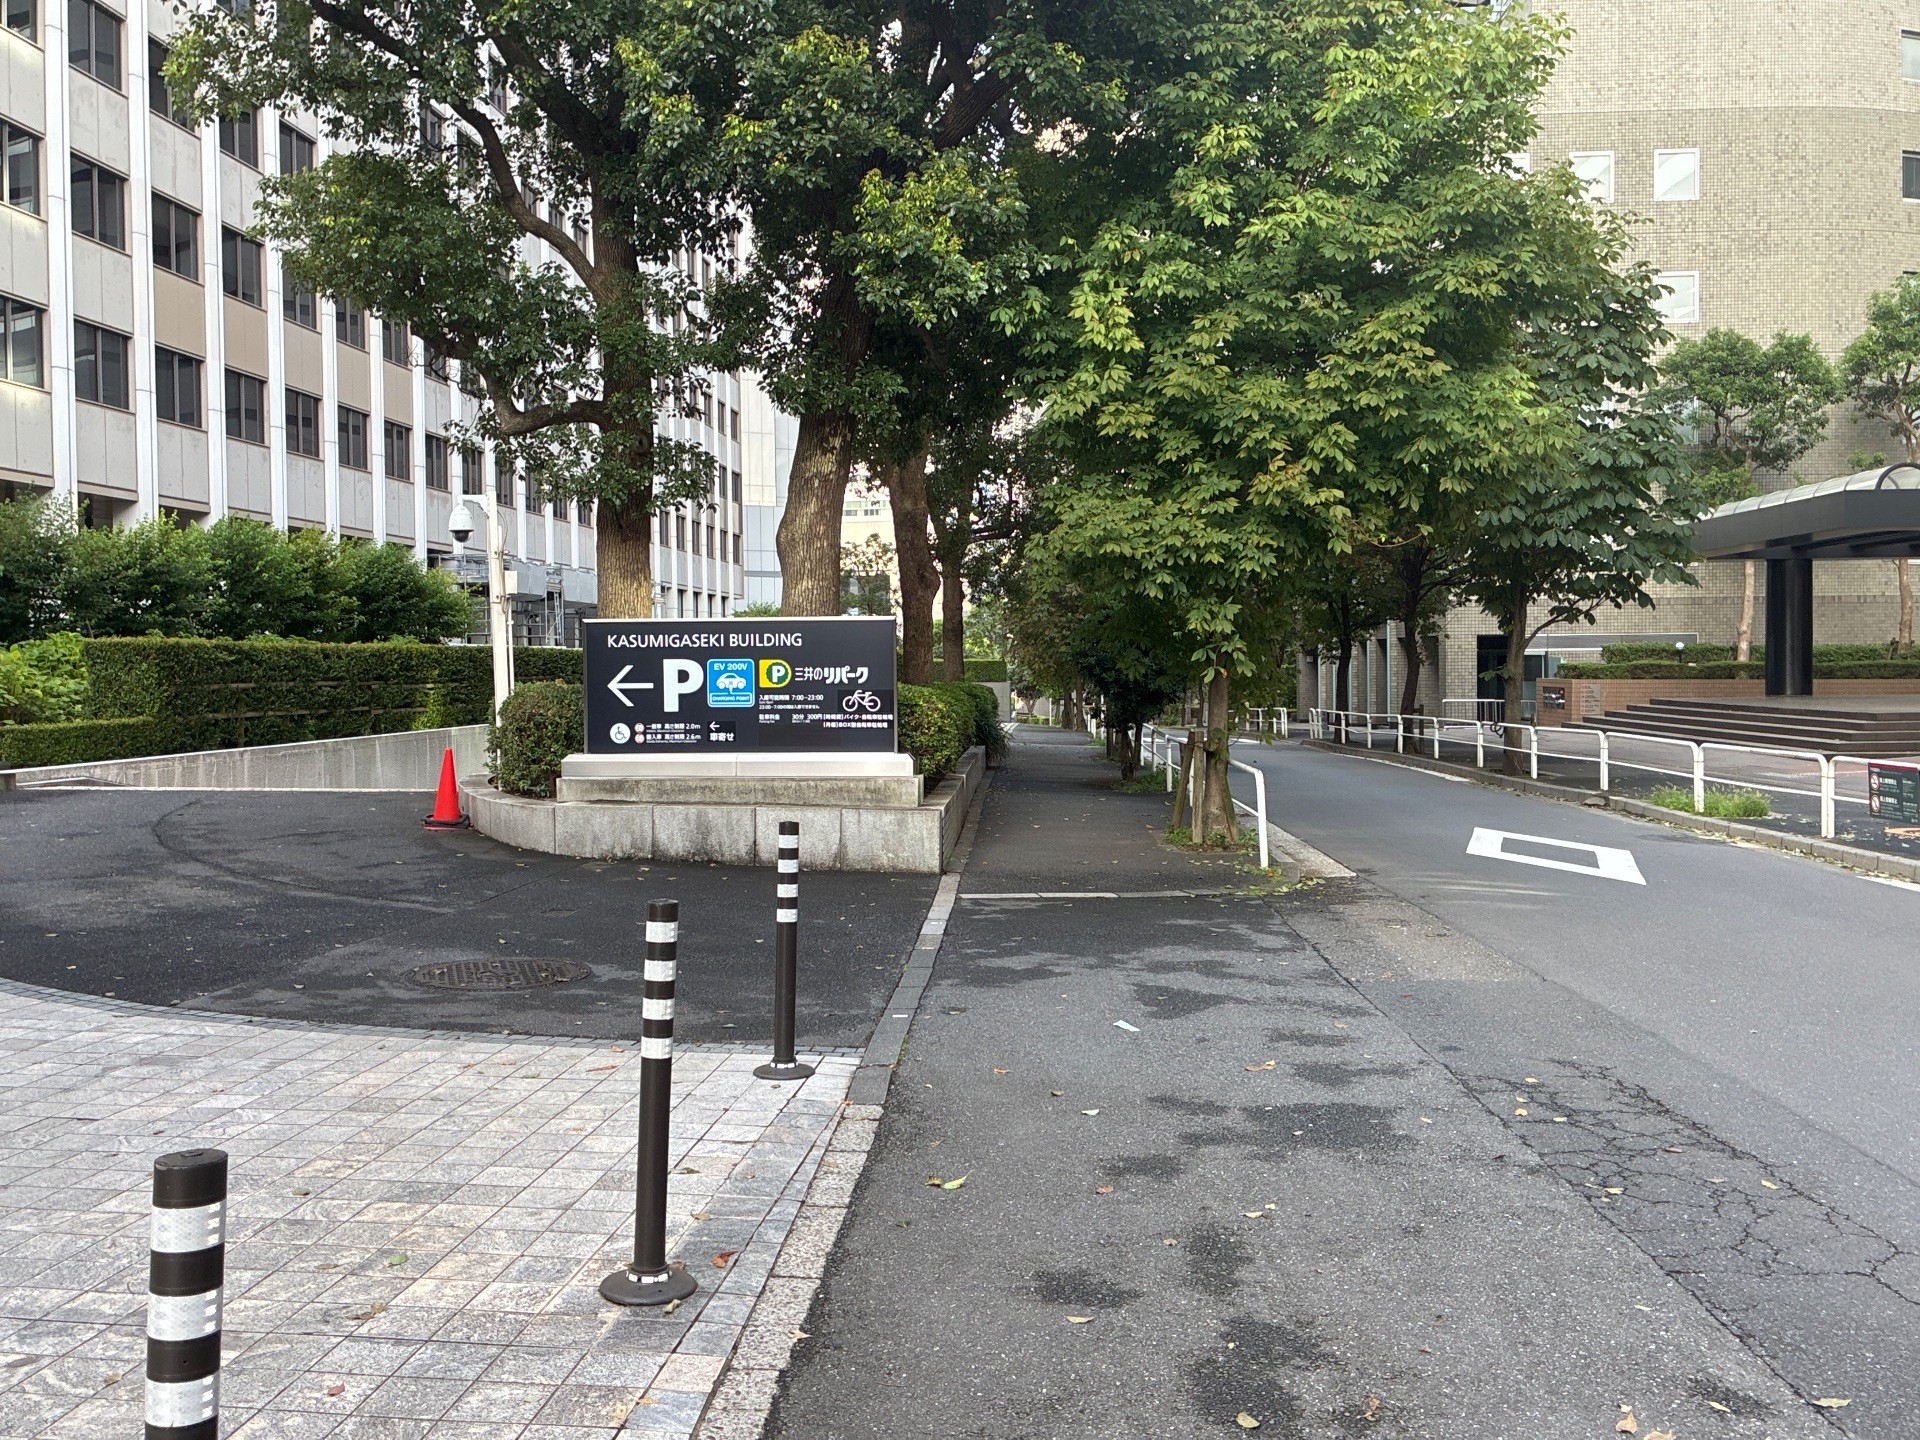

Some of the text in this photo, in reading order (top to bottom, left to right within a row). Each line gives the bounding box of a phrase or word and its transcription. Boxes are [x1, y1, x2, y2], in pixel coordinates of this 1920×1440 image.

[607, 633, 803, 648] KASUMIGASEKI BUILDING
[713, 663, 748, 671] EV 200V
[771, 665, 786, 683] P
[794, 665, 869, 685] 三井のリパーク
[662, 658, 704, 713] P
[709, 732, 735, 742] 車寄せ
